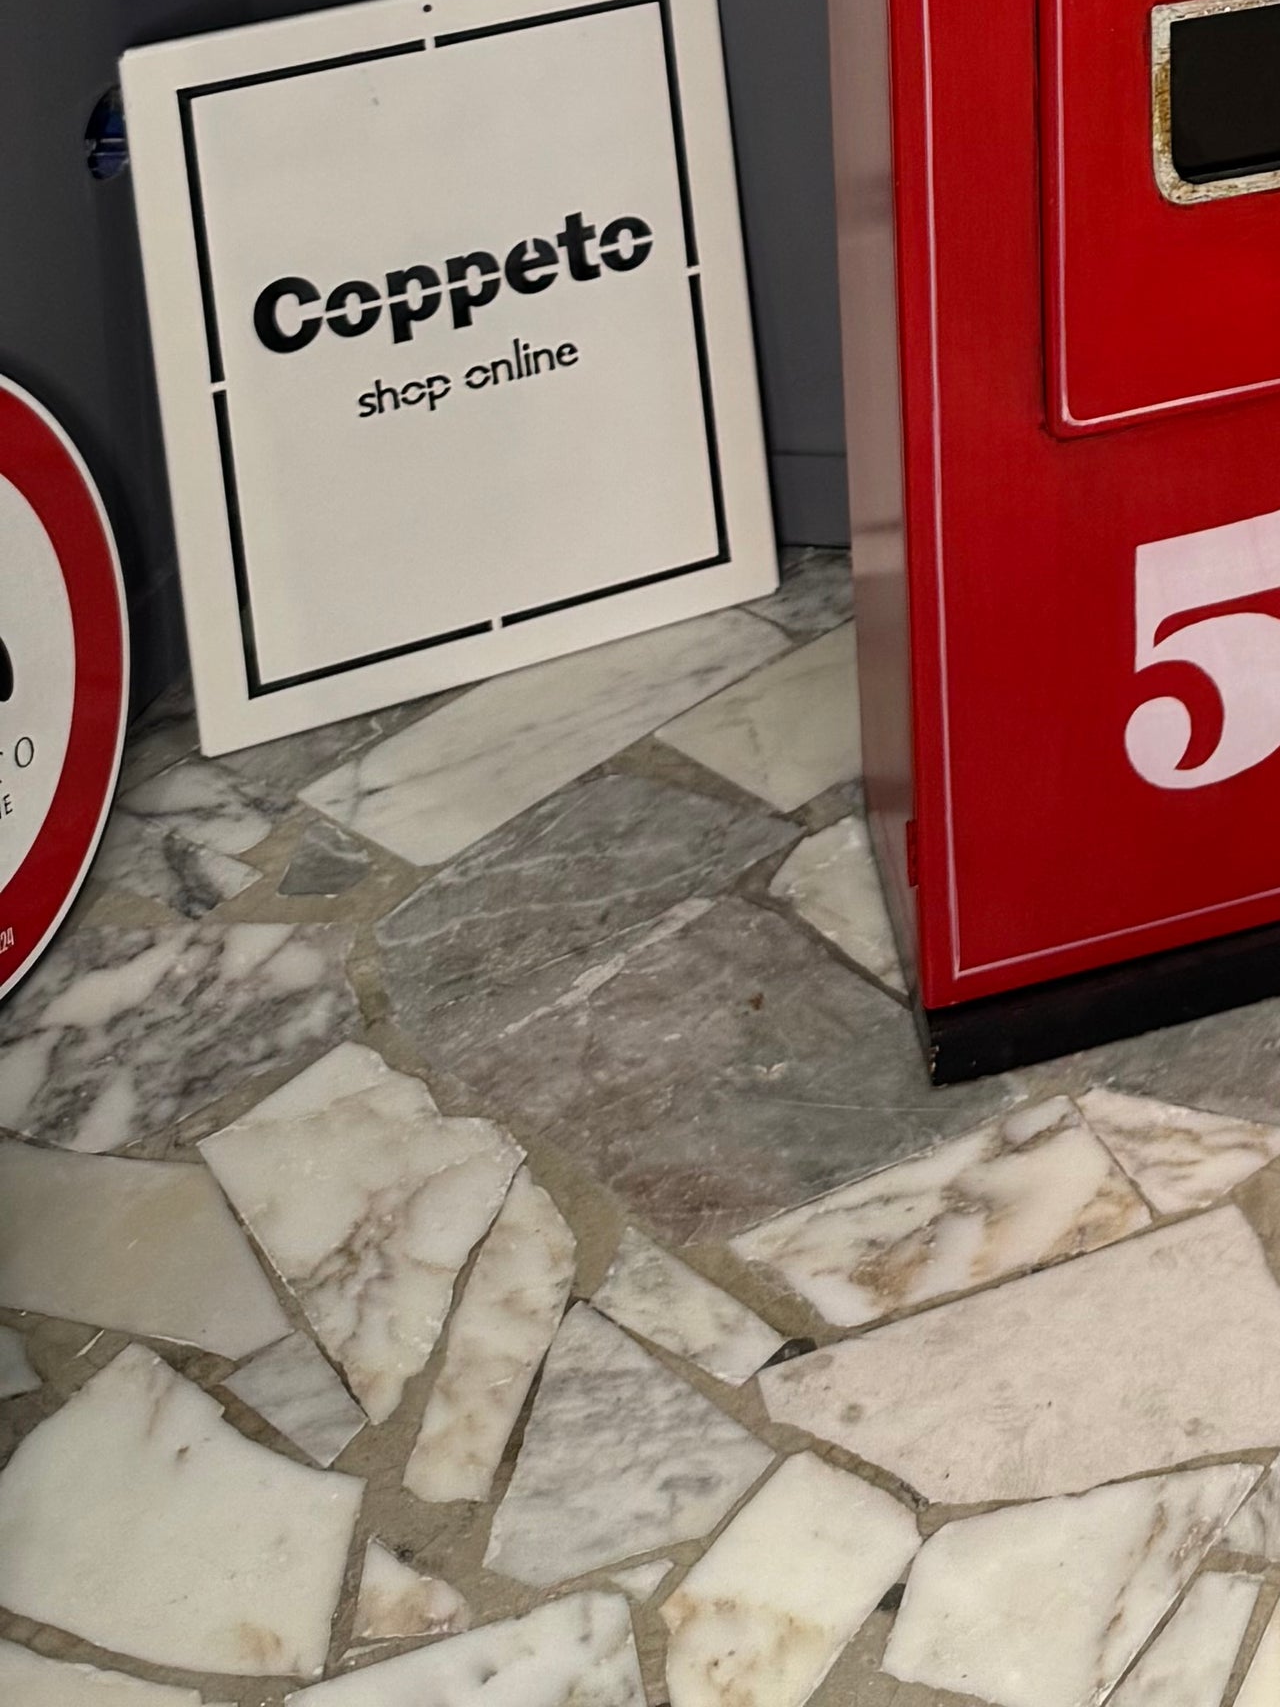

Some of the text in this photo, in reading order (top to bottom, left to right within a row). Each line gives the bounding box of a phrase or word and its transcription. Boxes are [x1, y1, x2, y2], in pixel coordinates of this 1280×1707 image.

[253, 211, 653, 354] Coppeto
[357, 337, 579, 419] shop online
